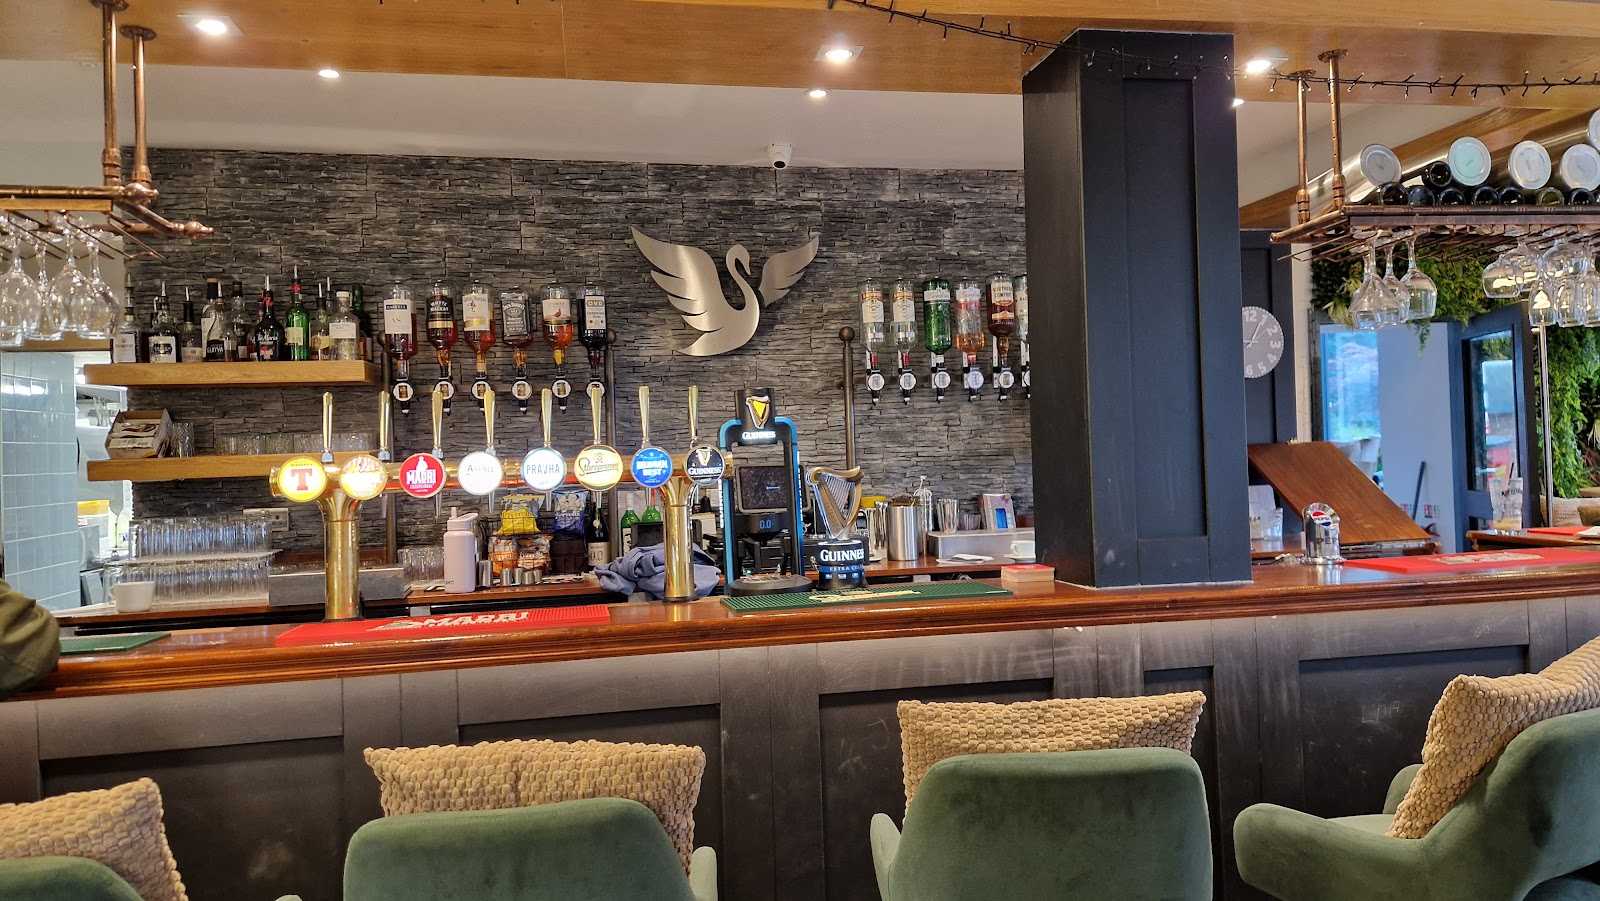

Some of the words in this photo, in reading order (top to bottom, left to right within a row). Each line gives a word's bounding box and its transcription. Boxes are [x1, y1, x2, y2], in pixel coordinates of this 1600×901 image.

[1243, 310, 1257, 322] 12
[688, 466, 723, 476] GUINNESS
[291, 468, 312, 491] T
[759, 520, 772, 529] 0.0
